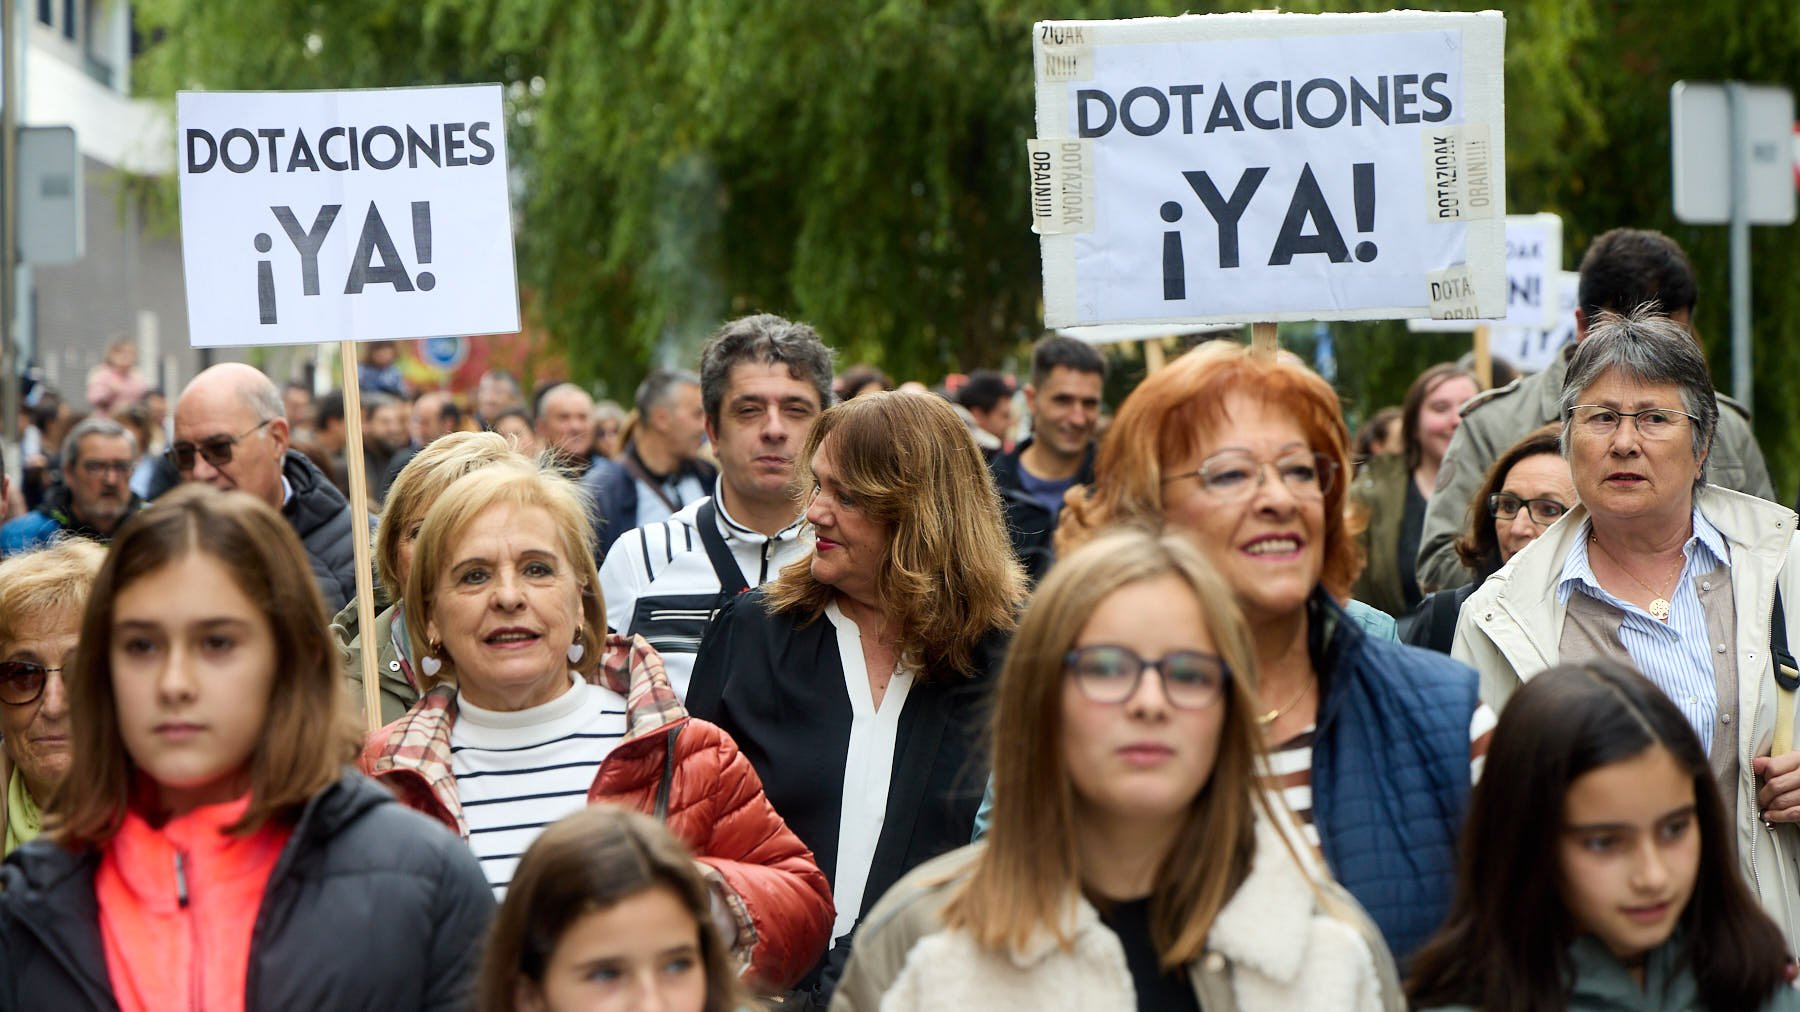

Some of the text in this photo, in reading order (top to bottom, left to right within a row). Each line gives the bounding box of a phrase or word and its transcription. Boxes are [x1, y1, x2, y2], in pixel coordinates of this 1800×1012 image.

[1077, 72, 1453, 138] DOTACIONES
[186, 121, 495, 174] DOTACIONES
[1032, 151, 1052, 217] ORAIN!!!!
[1061, 143, 1083, 225] DOTAZIOAK
[253, 199, 436, 325] ¡YA!
[1159, 162, 1378, 300] ¡YA!
